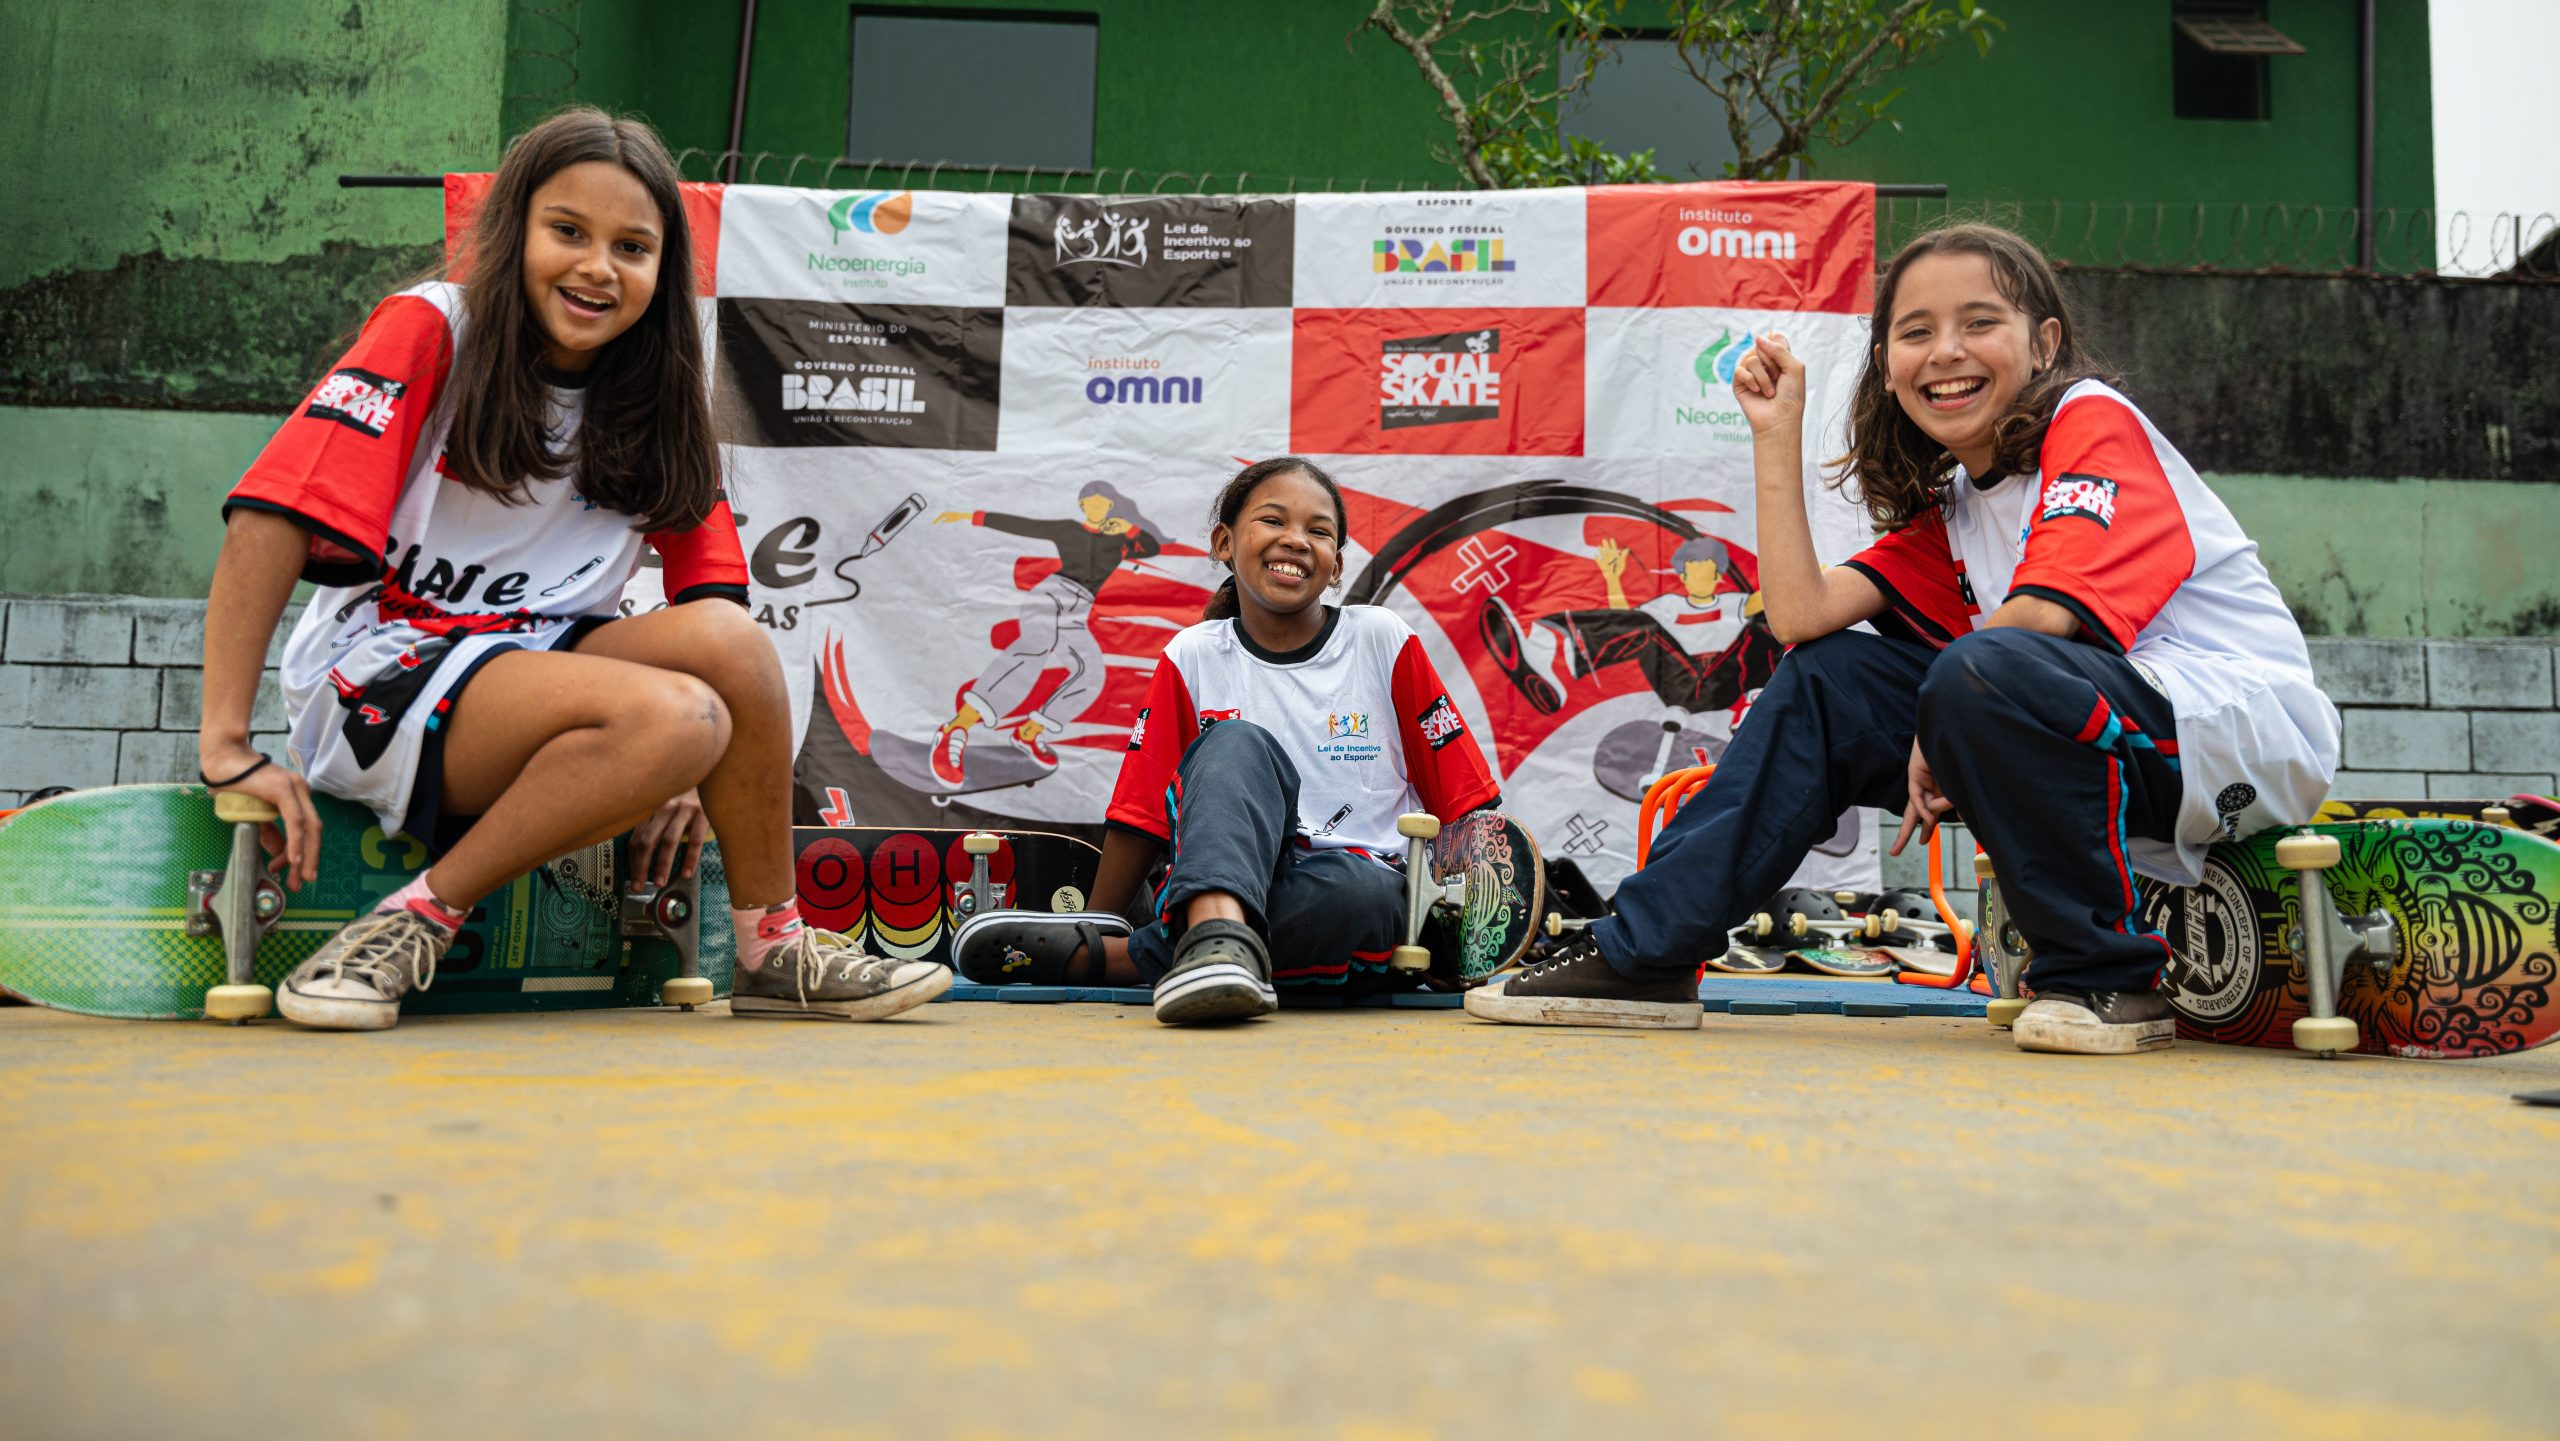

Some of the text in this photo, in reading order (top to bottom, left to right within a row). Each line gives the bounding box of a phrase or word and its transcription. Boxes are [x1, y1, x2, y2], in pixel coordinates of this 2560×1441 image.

[1679, 207, 1753, 224] instituto
[1163, 223, 1208, 234] Lei de
[1385, 225, 1504, 234] GOVERNO FEDERAL
[1163, 235, 1252, 248] Incentivo ao
[1163, 249, 1220, 261] Esporte
[1372, 239, 1516, 273] BRASIL
[807, 252, 926, 276] Neoenergia
[842, 277, 888, 289] Instituto
[1383, 277, 1504, 287] UNIÃO E RECONSTRUÇÃO
[889, 324, 908, 335] DO
[828, 334, 888, 347] ESPORTE
[794, 360, 917, 376] GOVERNO FEDERAL
[1088, 356, 1161, 370] instituto
[1381, 352, 1500, 383] SOCIAL
[781, 373, 926, 413] BRASIL
[1381, 377, 1500, 406] SKATE
[824, 415, 831, 423] E
[1317, 744, 1382, 753] Lei de Incentivo
[1343, 753, 1376, 762] Esporte
[2222, 915, 2234, 941] SINCE
[511, 909, 523, 963] PHOTO ART
[2196, 867, 2252, 1011] NEW CONCEPT OF SKATEBOARDS
